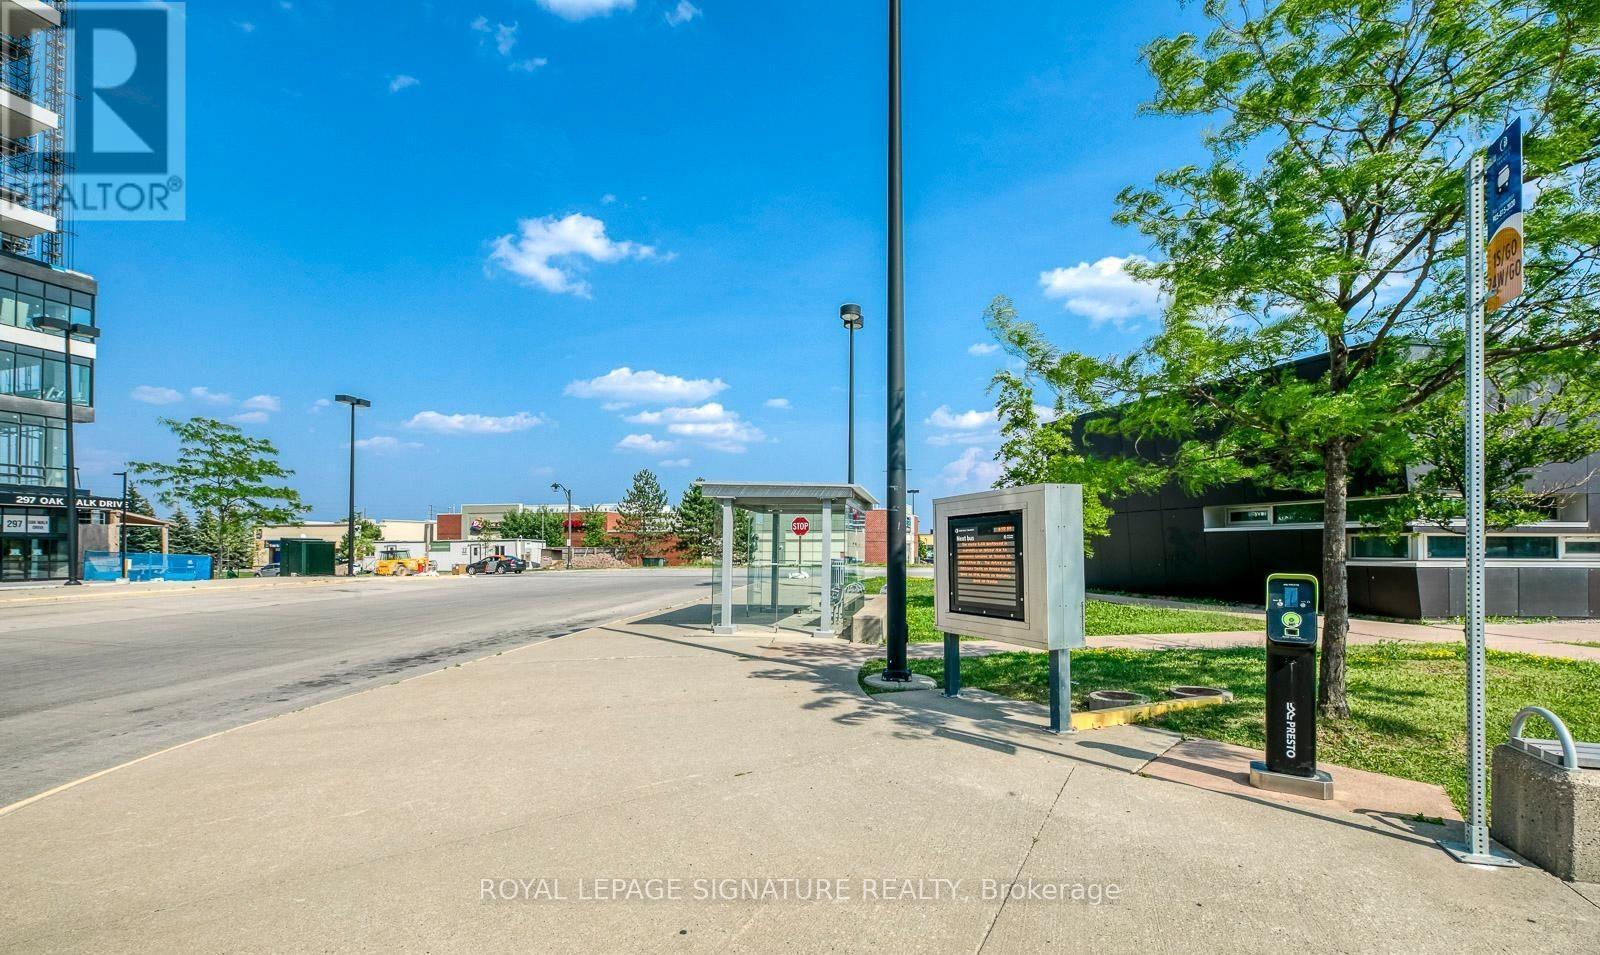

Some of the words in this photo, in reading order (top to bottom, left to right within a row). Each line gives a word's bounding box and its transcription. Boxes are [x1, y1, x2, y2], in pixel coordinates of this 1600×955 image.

[15, 495, 36, 504] 297
[40, 496, 65, 506] OAK
[7, 519, 23, 528] 297
[792, 522, 808, 530] STOP
[1286, 721, 1297, 759] PRESTO
